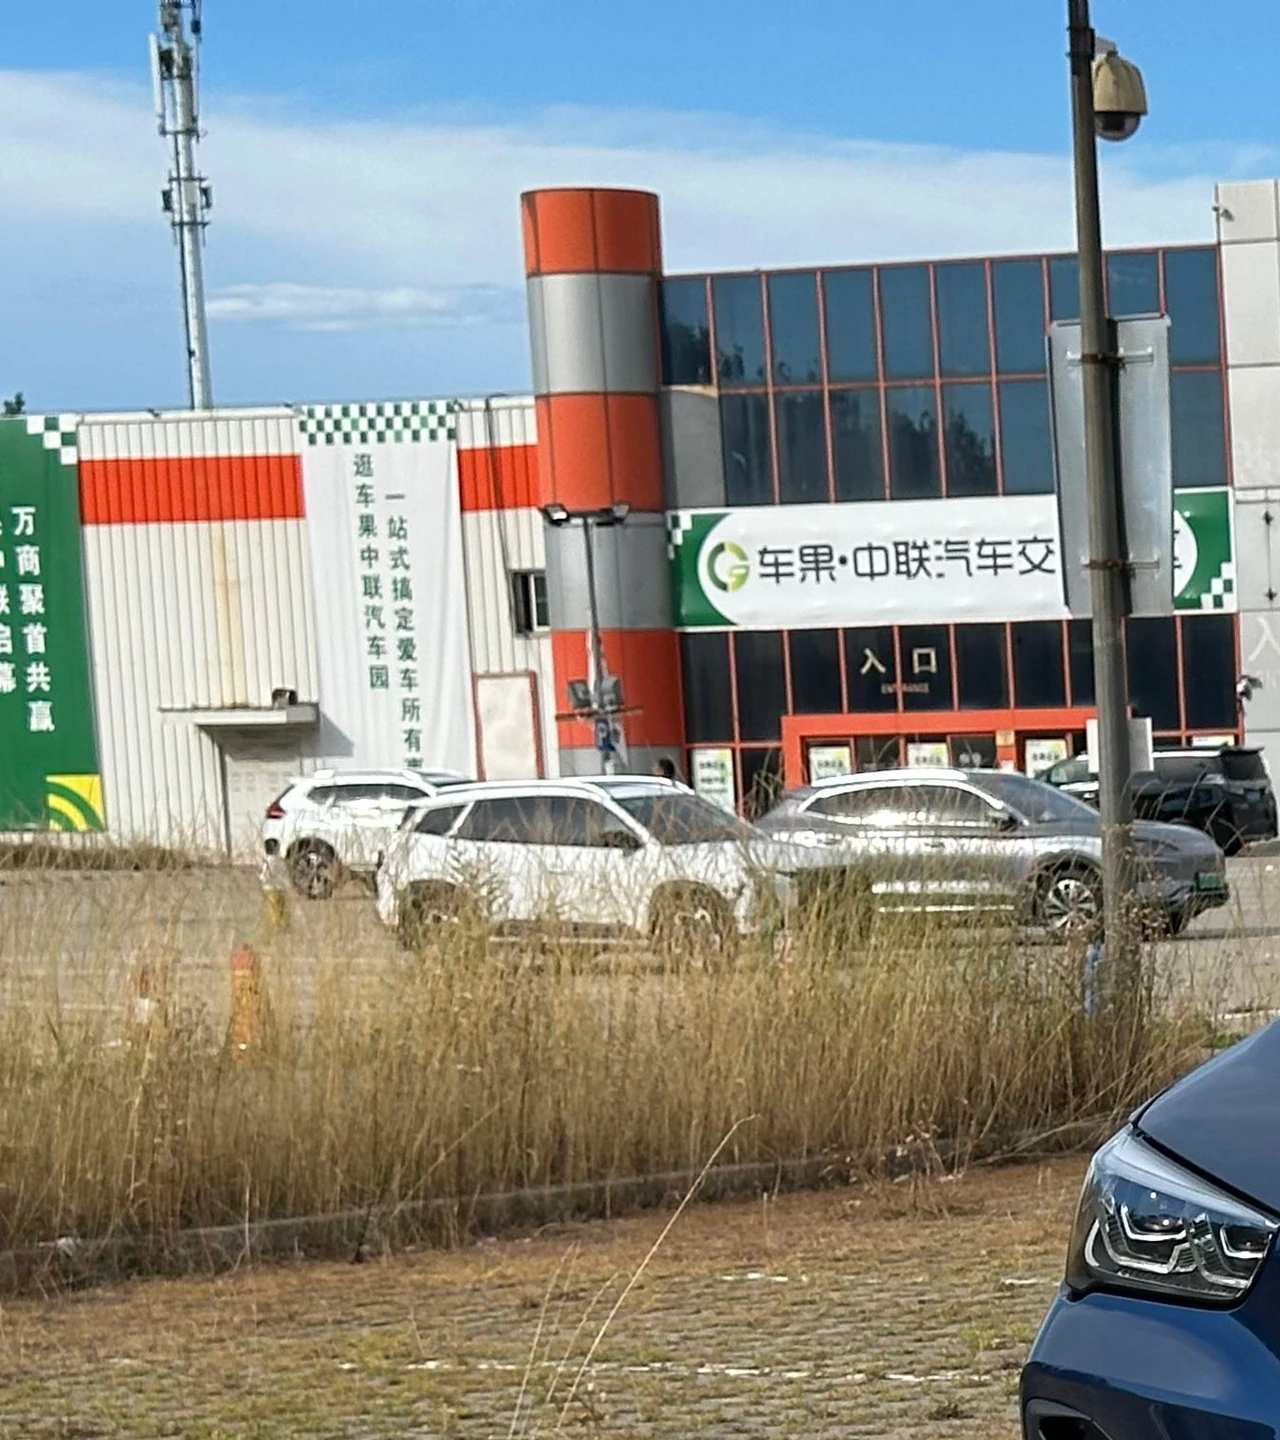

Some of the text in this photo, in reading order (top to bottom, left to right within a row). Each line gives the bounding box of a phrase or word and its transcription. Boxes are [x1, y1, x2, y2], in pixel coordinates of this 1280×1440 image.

[11, 506, 55, 732] 万商聚首共赢
[353, 453, 390, 690] 逛车果中联汽车园
[758, 524, 1188, 584] 车果·中联汽车交
[860, 647, 936, 675] 入口
